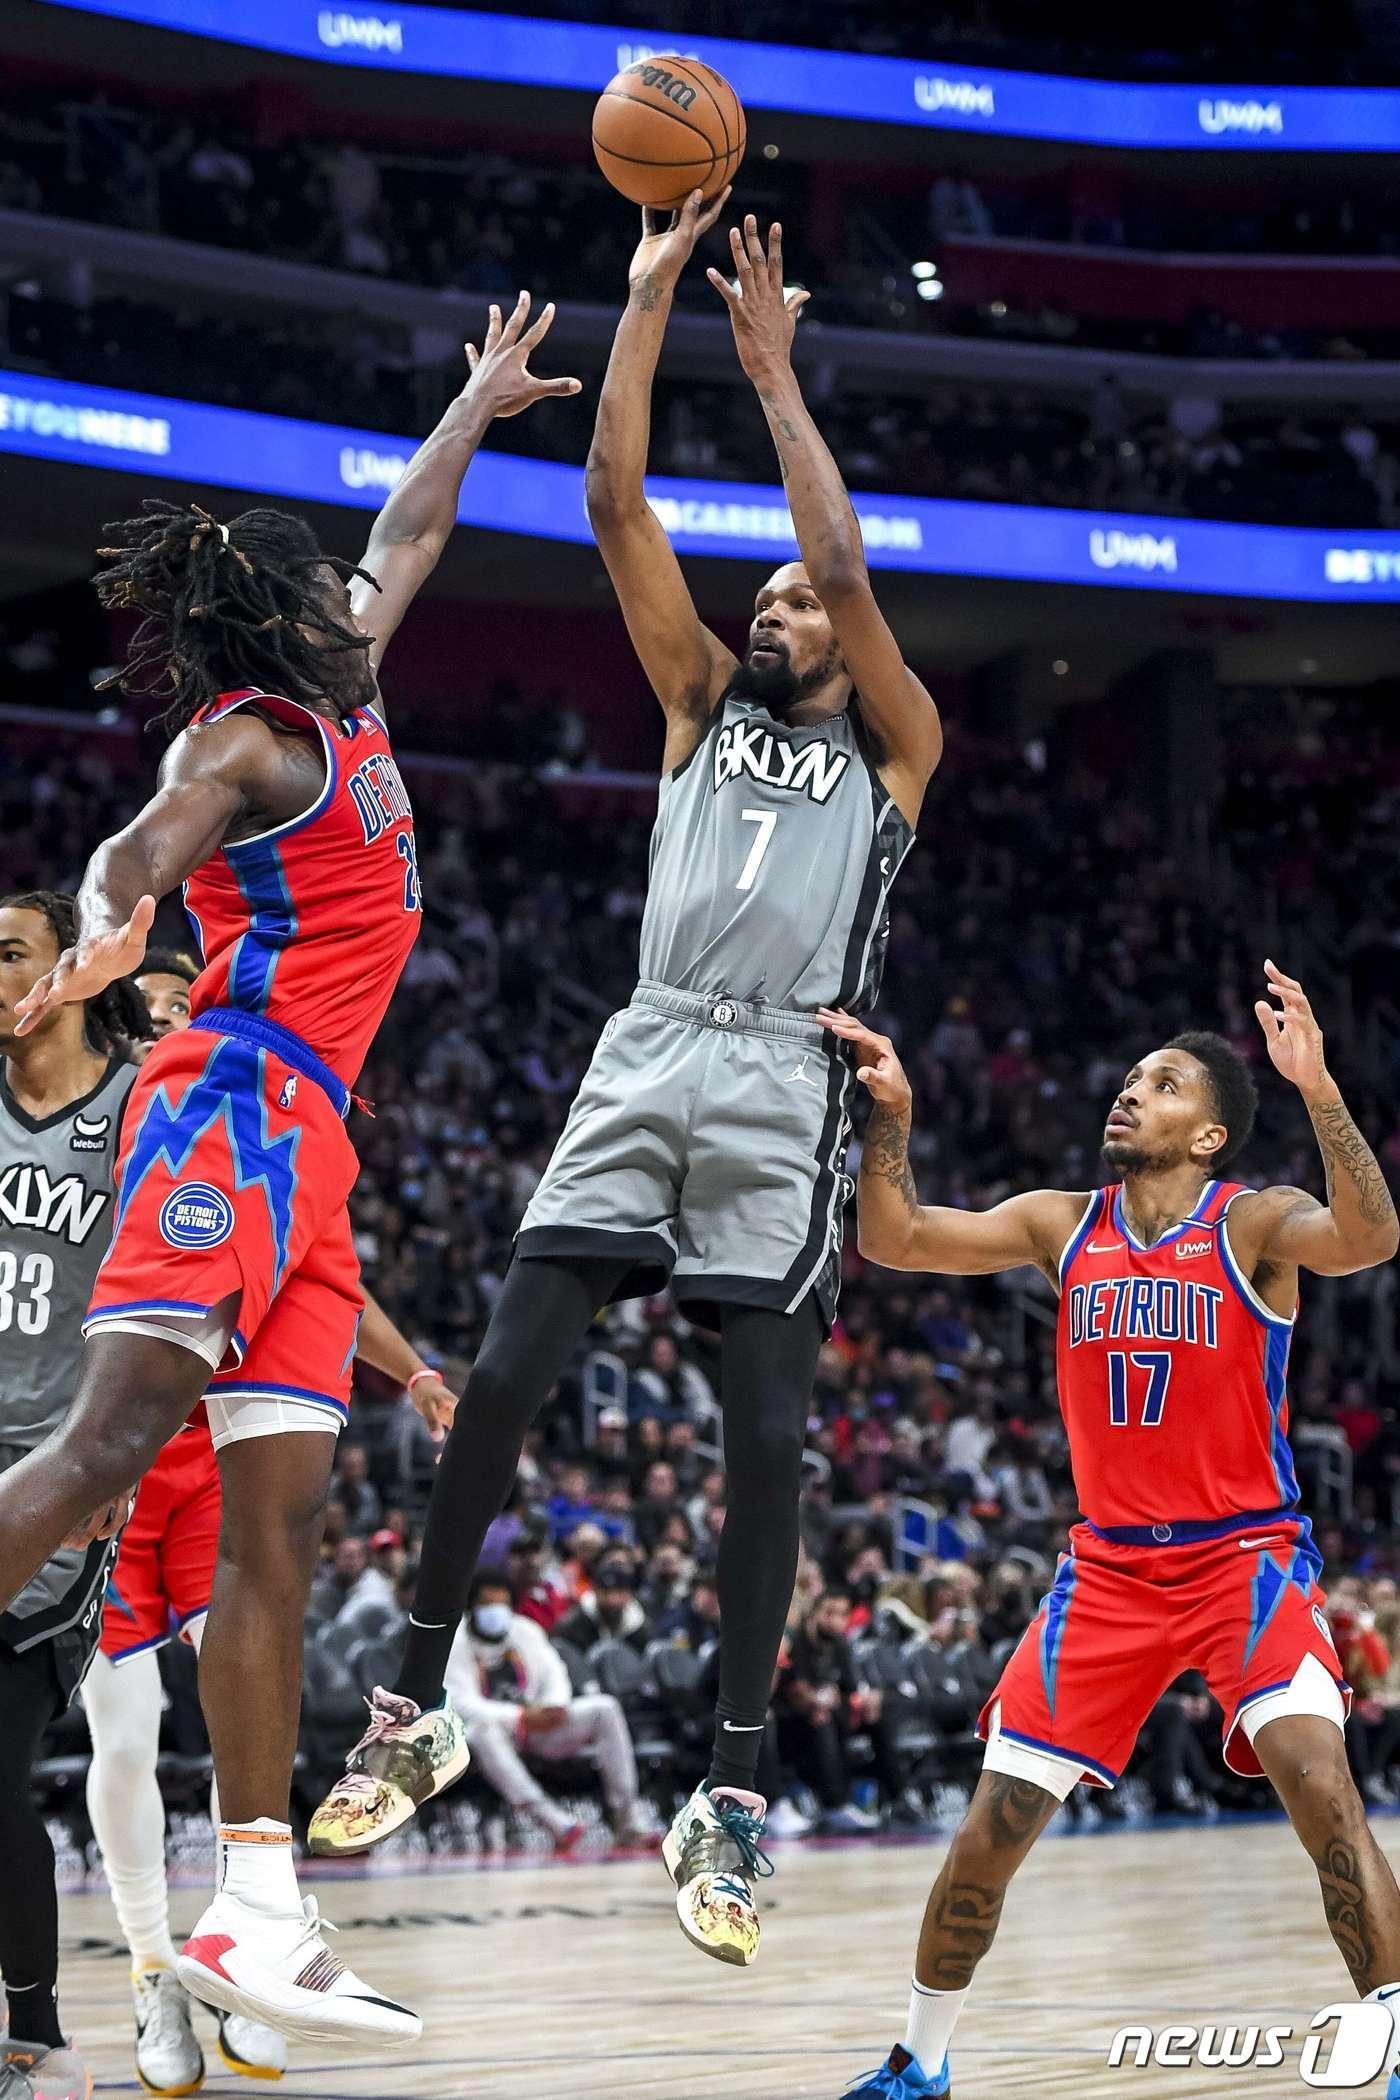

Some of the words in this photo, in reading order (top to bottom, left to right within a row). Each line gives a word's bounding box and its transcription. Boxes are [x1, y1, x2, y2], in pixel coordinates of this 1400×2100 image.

[714, 718, 851, 804] BKLYN
[396, 832, 423, 903] 2
[735, 809, 778, 890] 7
[73, 1138, 105, 1149] Webull
[173, 1214, 218, 1230] PISTONS
[176, 1204, 220, 1220] DETROIT
[1174, 1240, 1213, 1258] UWM
[1069, 1276, 1224, 1350] DETROIT
[1107, 1351, 1172, 1426] 17
